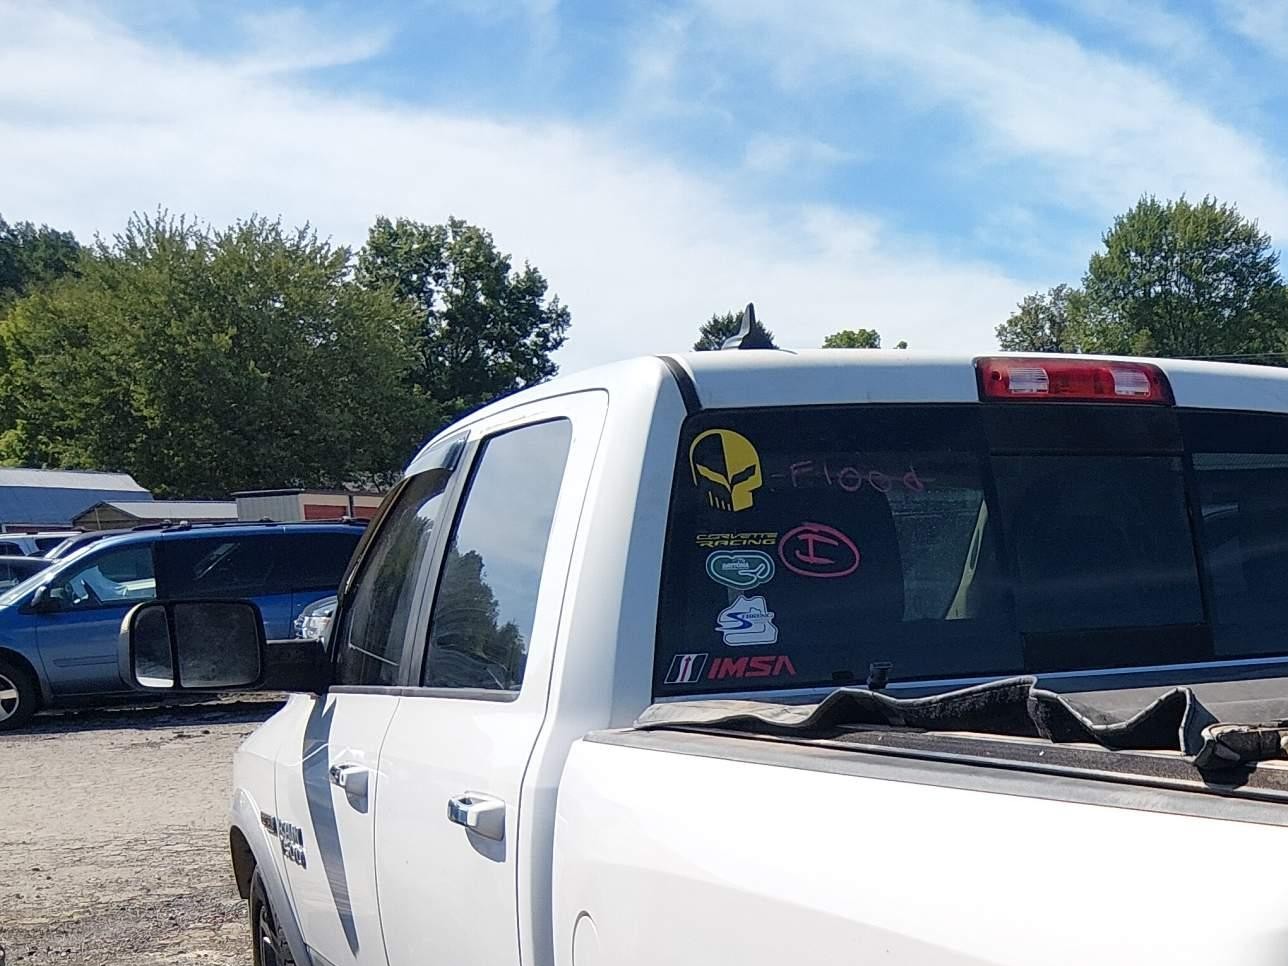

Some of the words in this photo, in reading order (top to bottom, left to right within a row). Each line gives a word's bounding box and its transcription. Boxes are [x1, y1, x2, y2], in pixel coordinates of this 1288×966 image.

[696, 532, 778, 540] CORVETTE
[695, 538, 777, 548] RACING
[707, 654, 797, 679] IMSA
